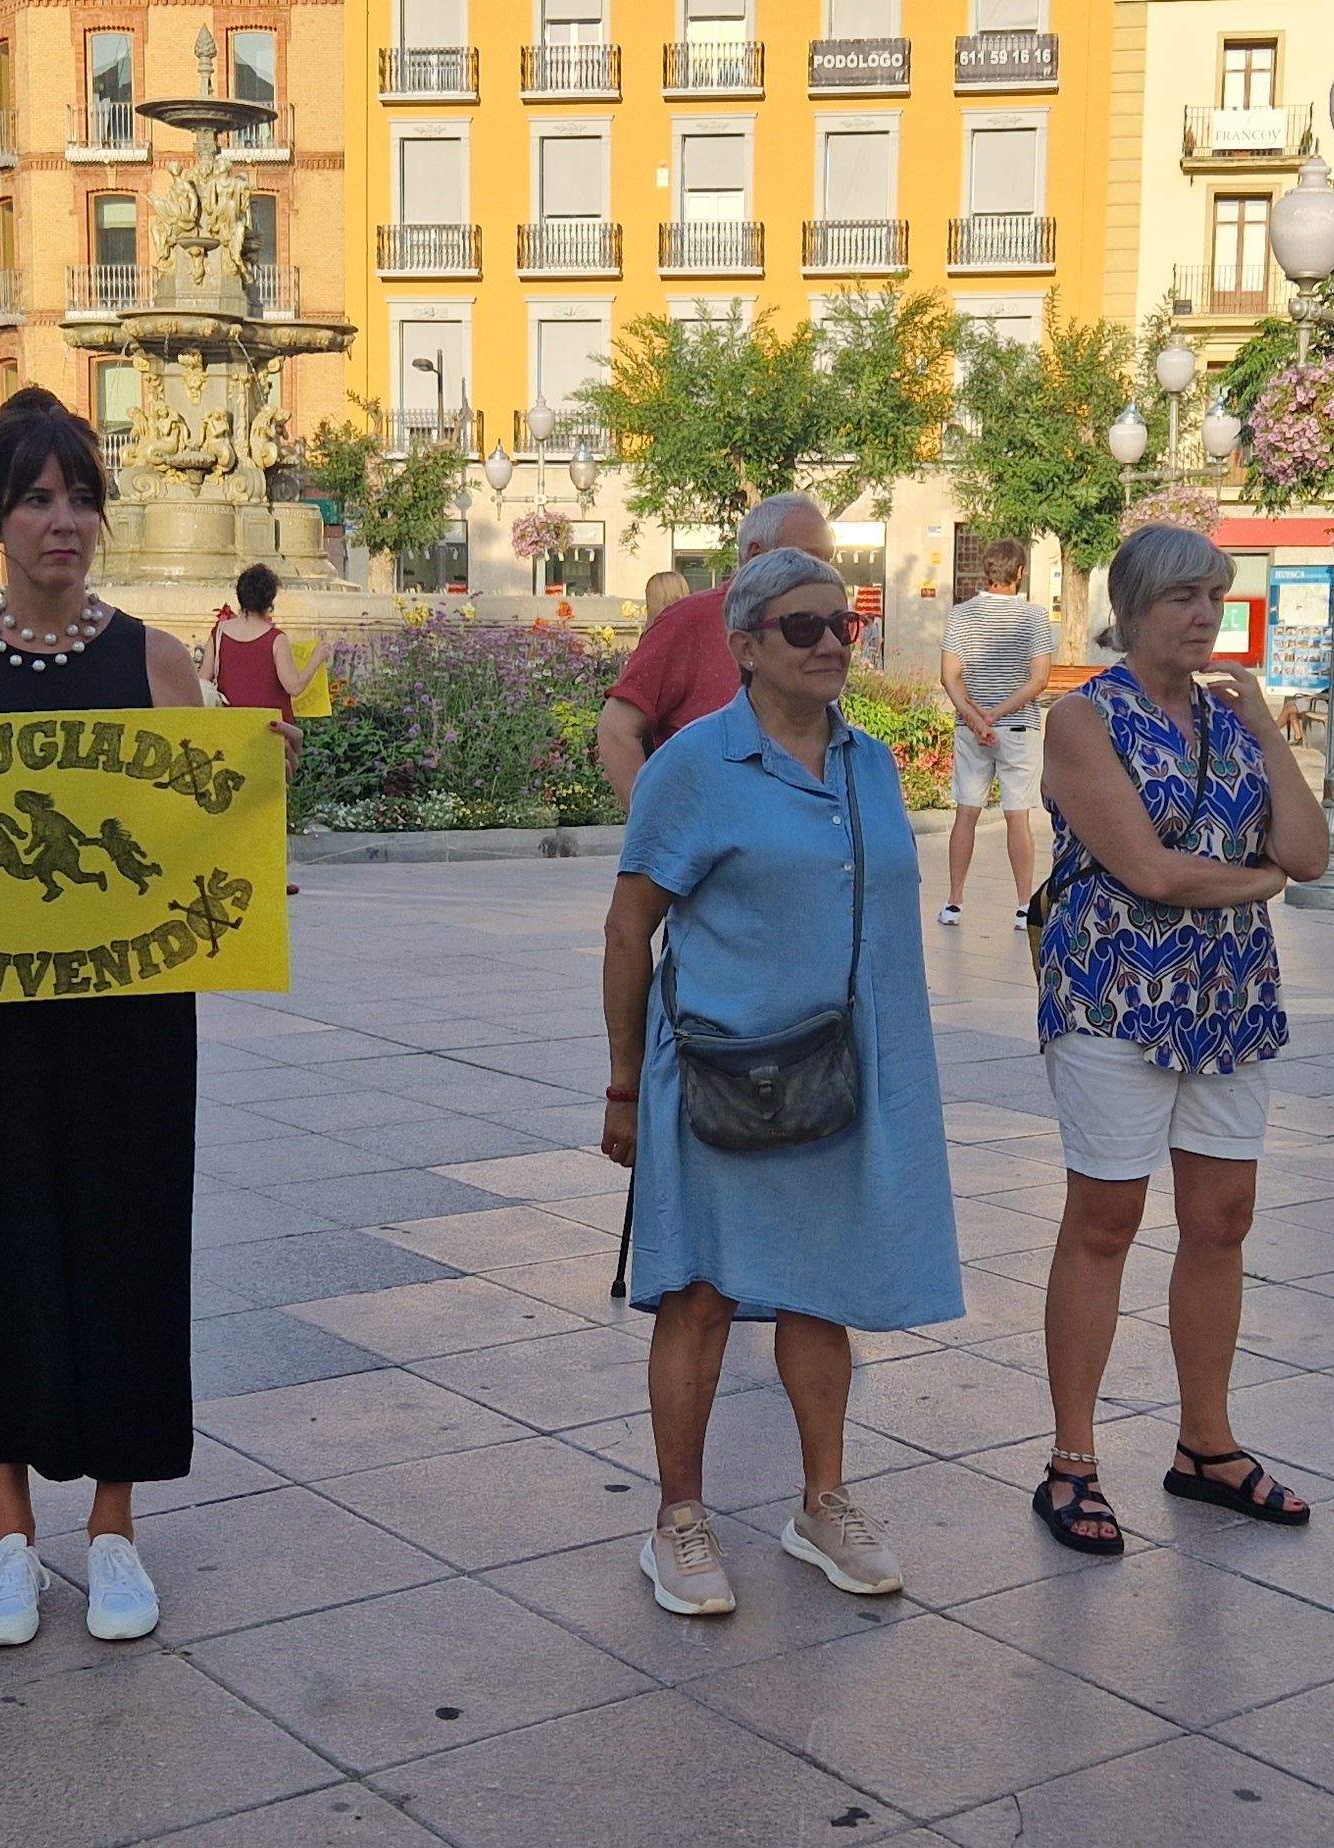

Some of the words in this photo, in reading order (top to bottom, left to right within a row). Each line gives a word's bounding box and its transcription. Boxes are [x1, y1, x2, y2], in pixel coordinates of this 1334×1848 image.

[813, 51, 904, 69] PODÓLOGO
[959, 50, 985, 66] 611
[990, 50, 1008, 65] 59
[1012, 49, 1029, 64] 16
[1034, 48, 1052, 63] 16
